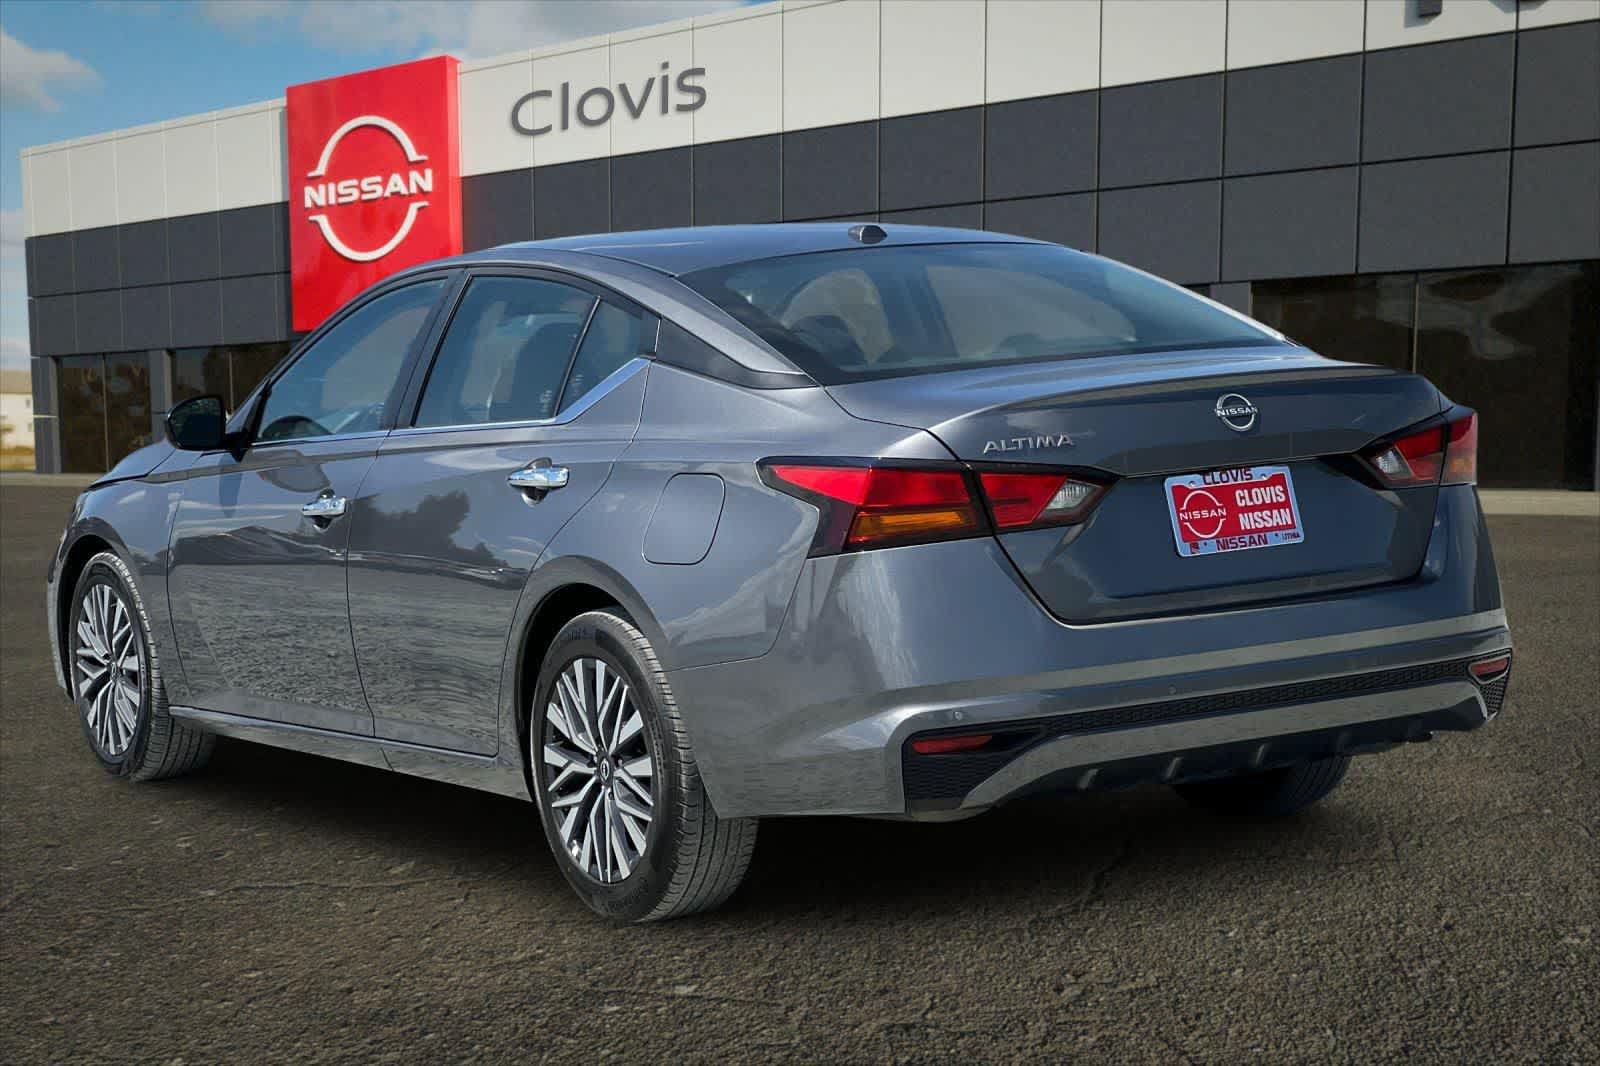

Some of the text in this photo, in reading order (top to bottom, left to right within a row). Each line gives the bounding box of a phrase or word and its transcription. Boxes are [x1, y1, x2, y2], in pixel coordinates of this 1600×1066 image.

[511, 61, 706, 136] Clovis
[304, 169, 433, 208] NISSAN
[983, 433, 1074, 454] ALTIMA
[1236, 486, 1285, 506] CLOVIS
[1180, 508, 1227, 521] NISSAN
[1239, 509, 1292, 530] NISSAN
[1216, 534, 1268, 551] NISSAN
